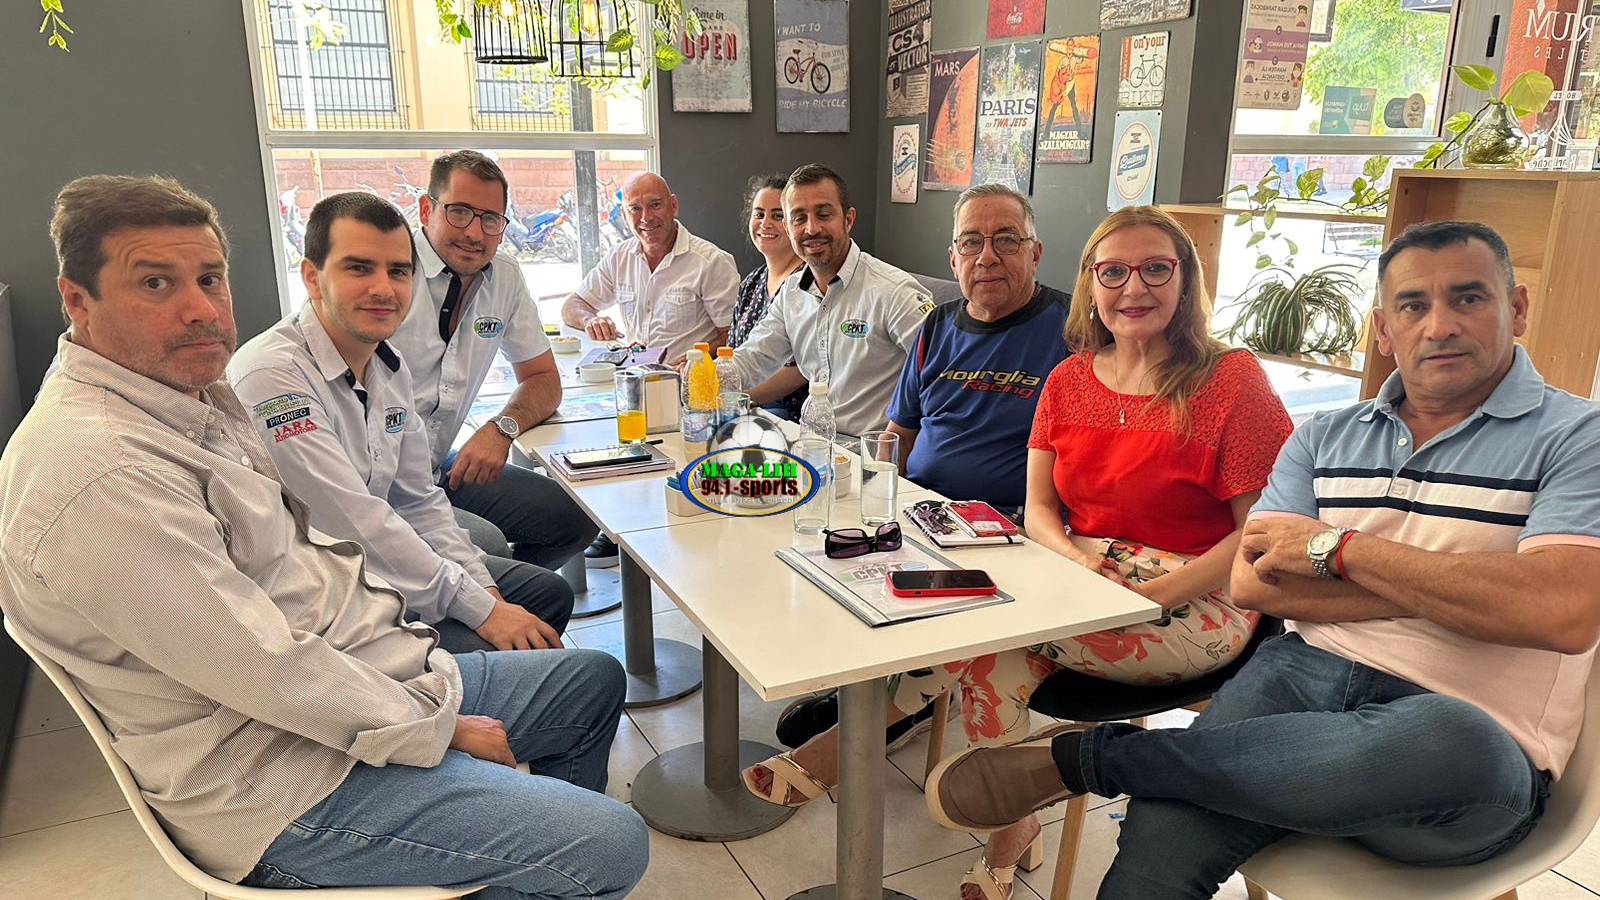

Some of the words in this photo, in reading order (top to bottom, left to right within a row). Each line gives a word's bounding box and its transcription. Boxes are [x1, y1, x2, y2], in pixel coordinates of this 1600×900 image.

[889, 0, 931, 31] ILLUSTRATOR
[782, 24, 807, 36] WANT
[808, 22, 821, 32] TO
[681, 31, 738, 61] OPEN
[1133, 37, 1144, 49] on
[1144, 34, 1166, 51] your
[898, 43, 927, 72] VECTOR
[934, 60, 960, 77] MARS
[812, 98, 847, 109] BICYCLE
[980, 97, 1036, 117] PARIS
[993, 118, 1009, 128] TWA
[1009, 117, 1028, 128] JETS
[1049, 130, 1079, 140] MAGYAR
[847, 323, 865, 334] CPKT
[940, 369, 1041, 387] Mourglia
[961, 380, 1035, 399] Racing
[268, 409, 307, 427] PRONEC
[273, 418, 315, 438] JARA
[275, 425, 318, 444] AUTOMOTORES
